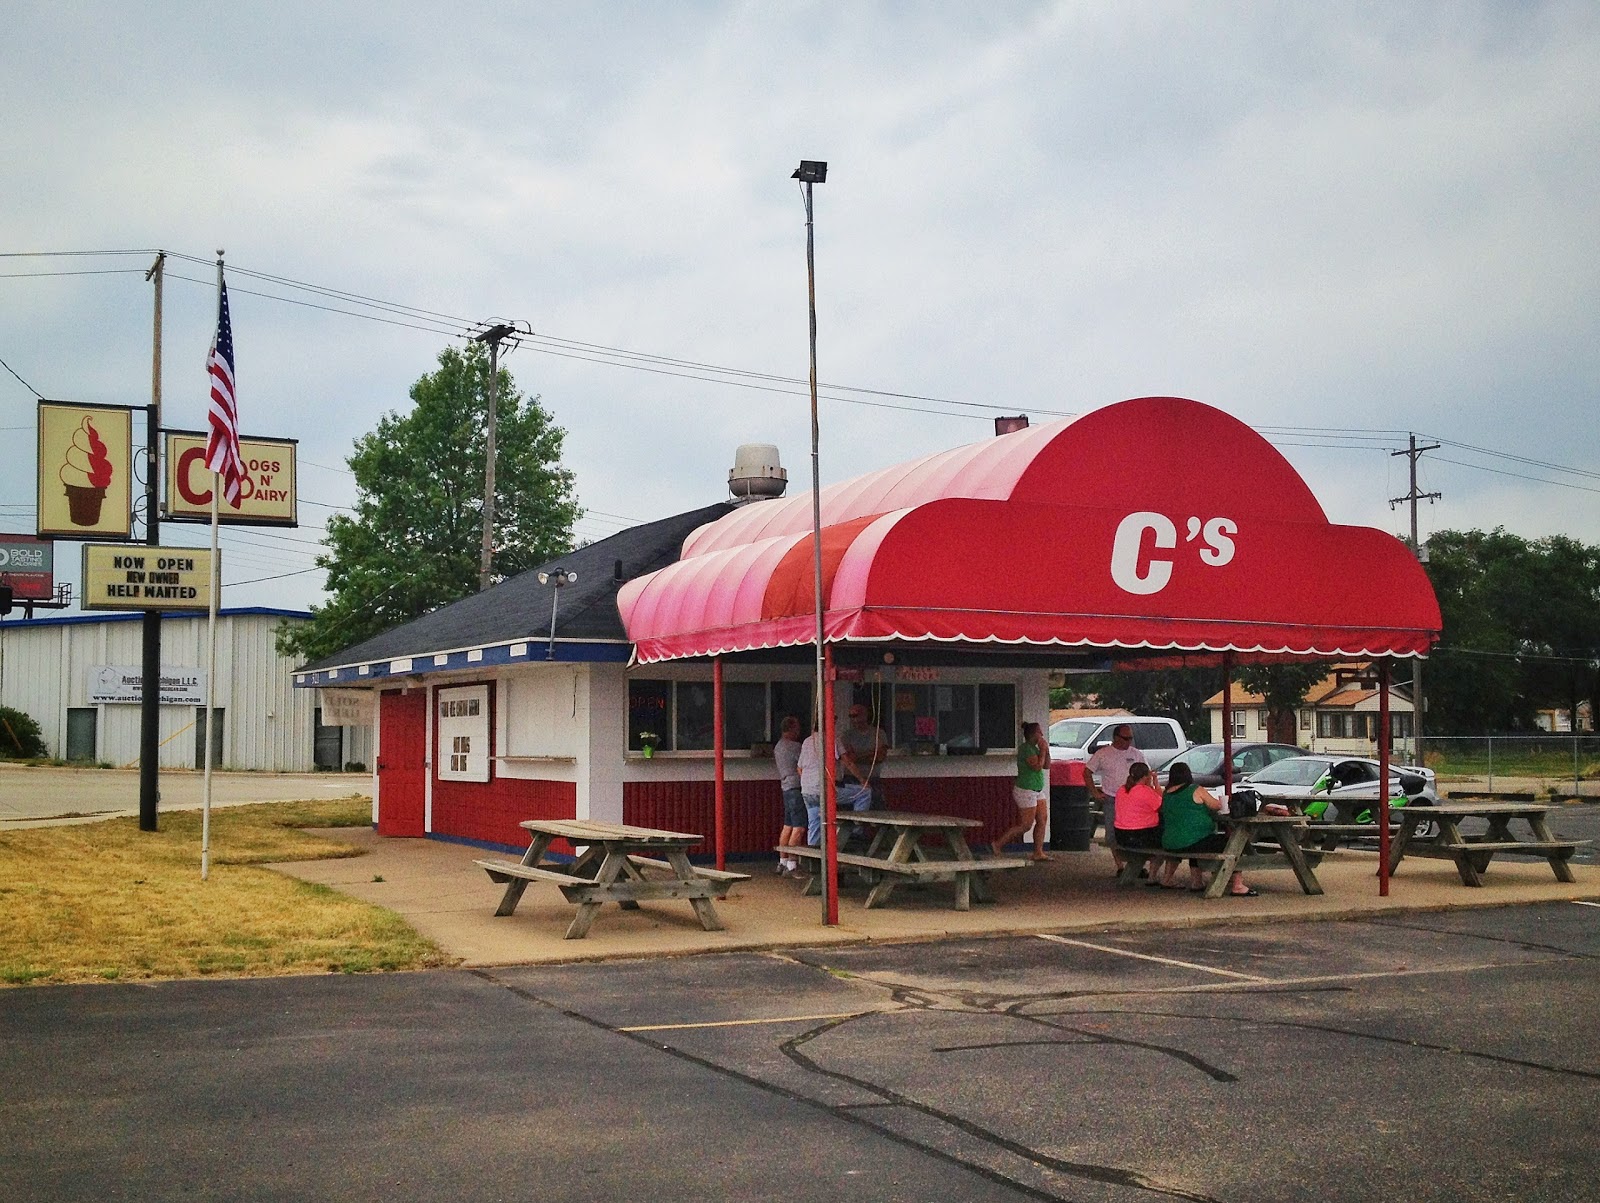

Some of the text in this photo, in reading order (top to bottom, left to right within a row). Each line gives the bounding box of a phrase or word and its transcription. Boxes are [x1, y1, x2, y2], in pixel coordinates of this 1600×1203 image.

[10, 549, 43, 557] BOLD
[114, 556, 193, 571] NOW OPEN
[126, 570, 180, 584] NEW OWNER
[107, 584, 197, 599] HELP WANTED
[121, 675, 144, 685] Aucti
[92, 695, 201, 703] www.auctiohigan.com
